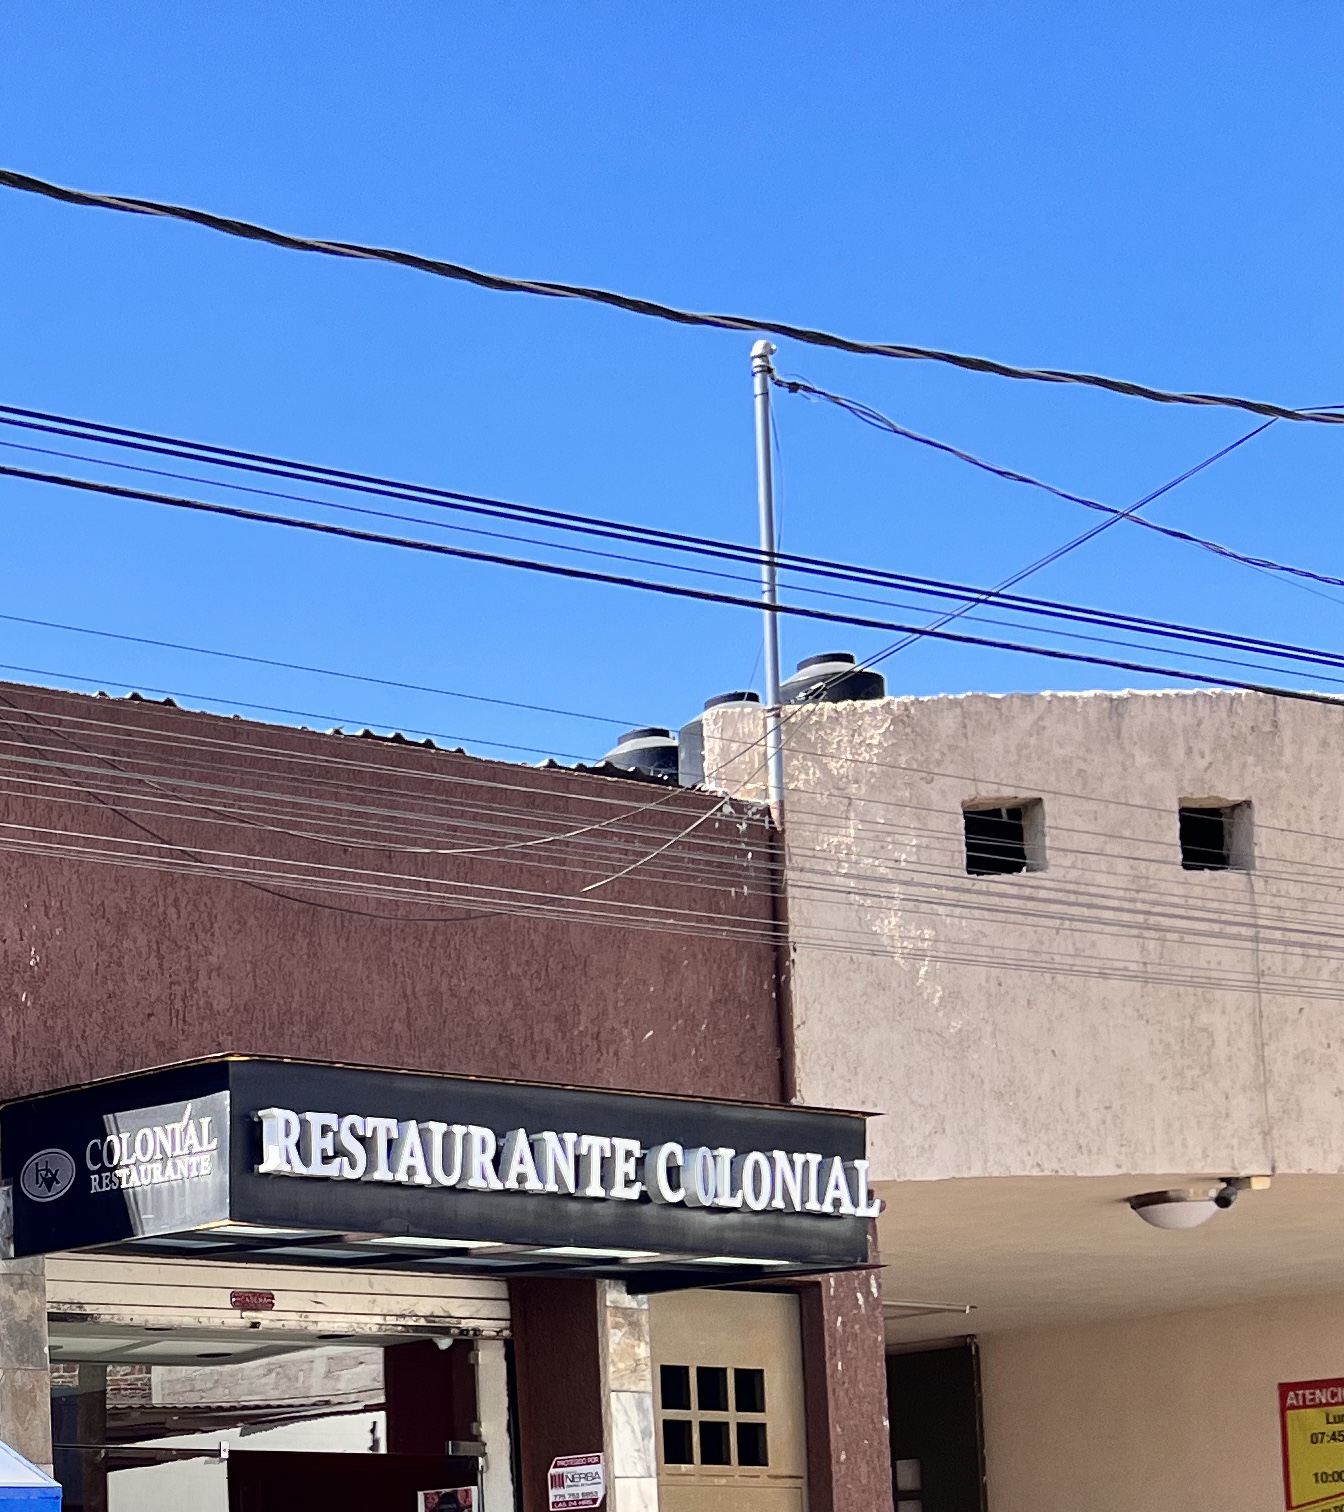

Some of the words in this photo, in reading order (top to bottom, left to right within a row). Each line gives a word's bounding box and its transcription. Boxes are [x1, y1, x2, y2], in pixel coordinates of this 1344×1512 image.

[89, 1153, 212, 1194] RESTAURANTE
[257, 1107, 643, 1201] RESTAURANTE
[650, 1140, 882, 1218] COLONIAL
[1286, 1386, 1344, 1406] ATENCI
[565, 1470, 602, 1484] NERBA
